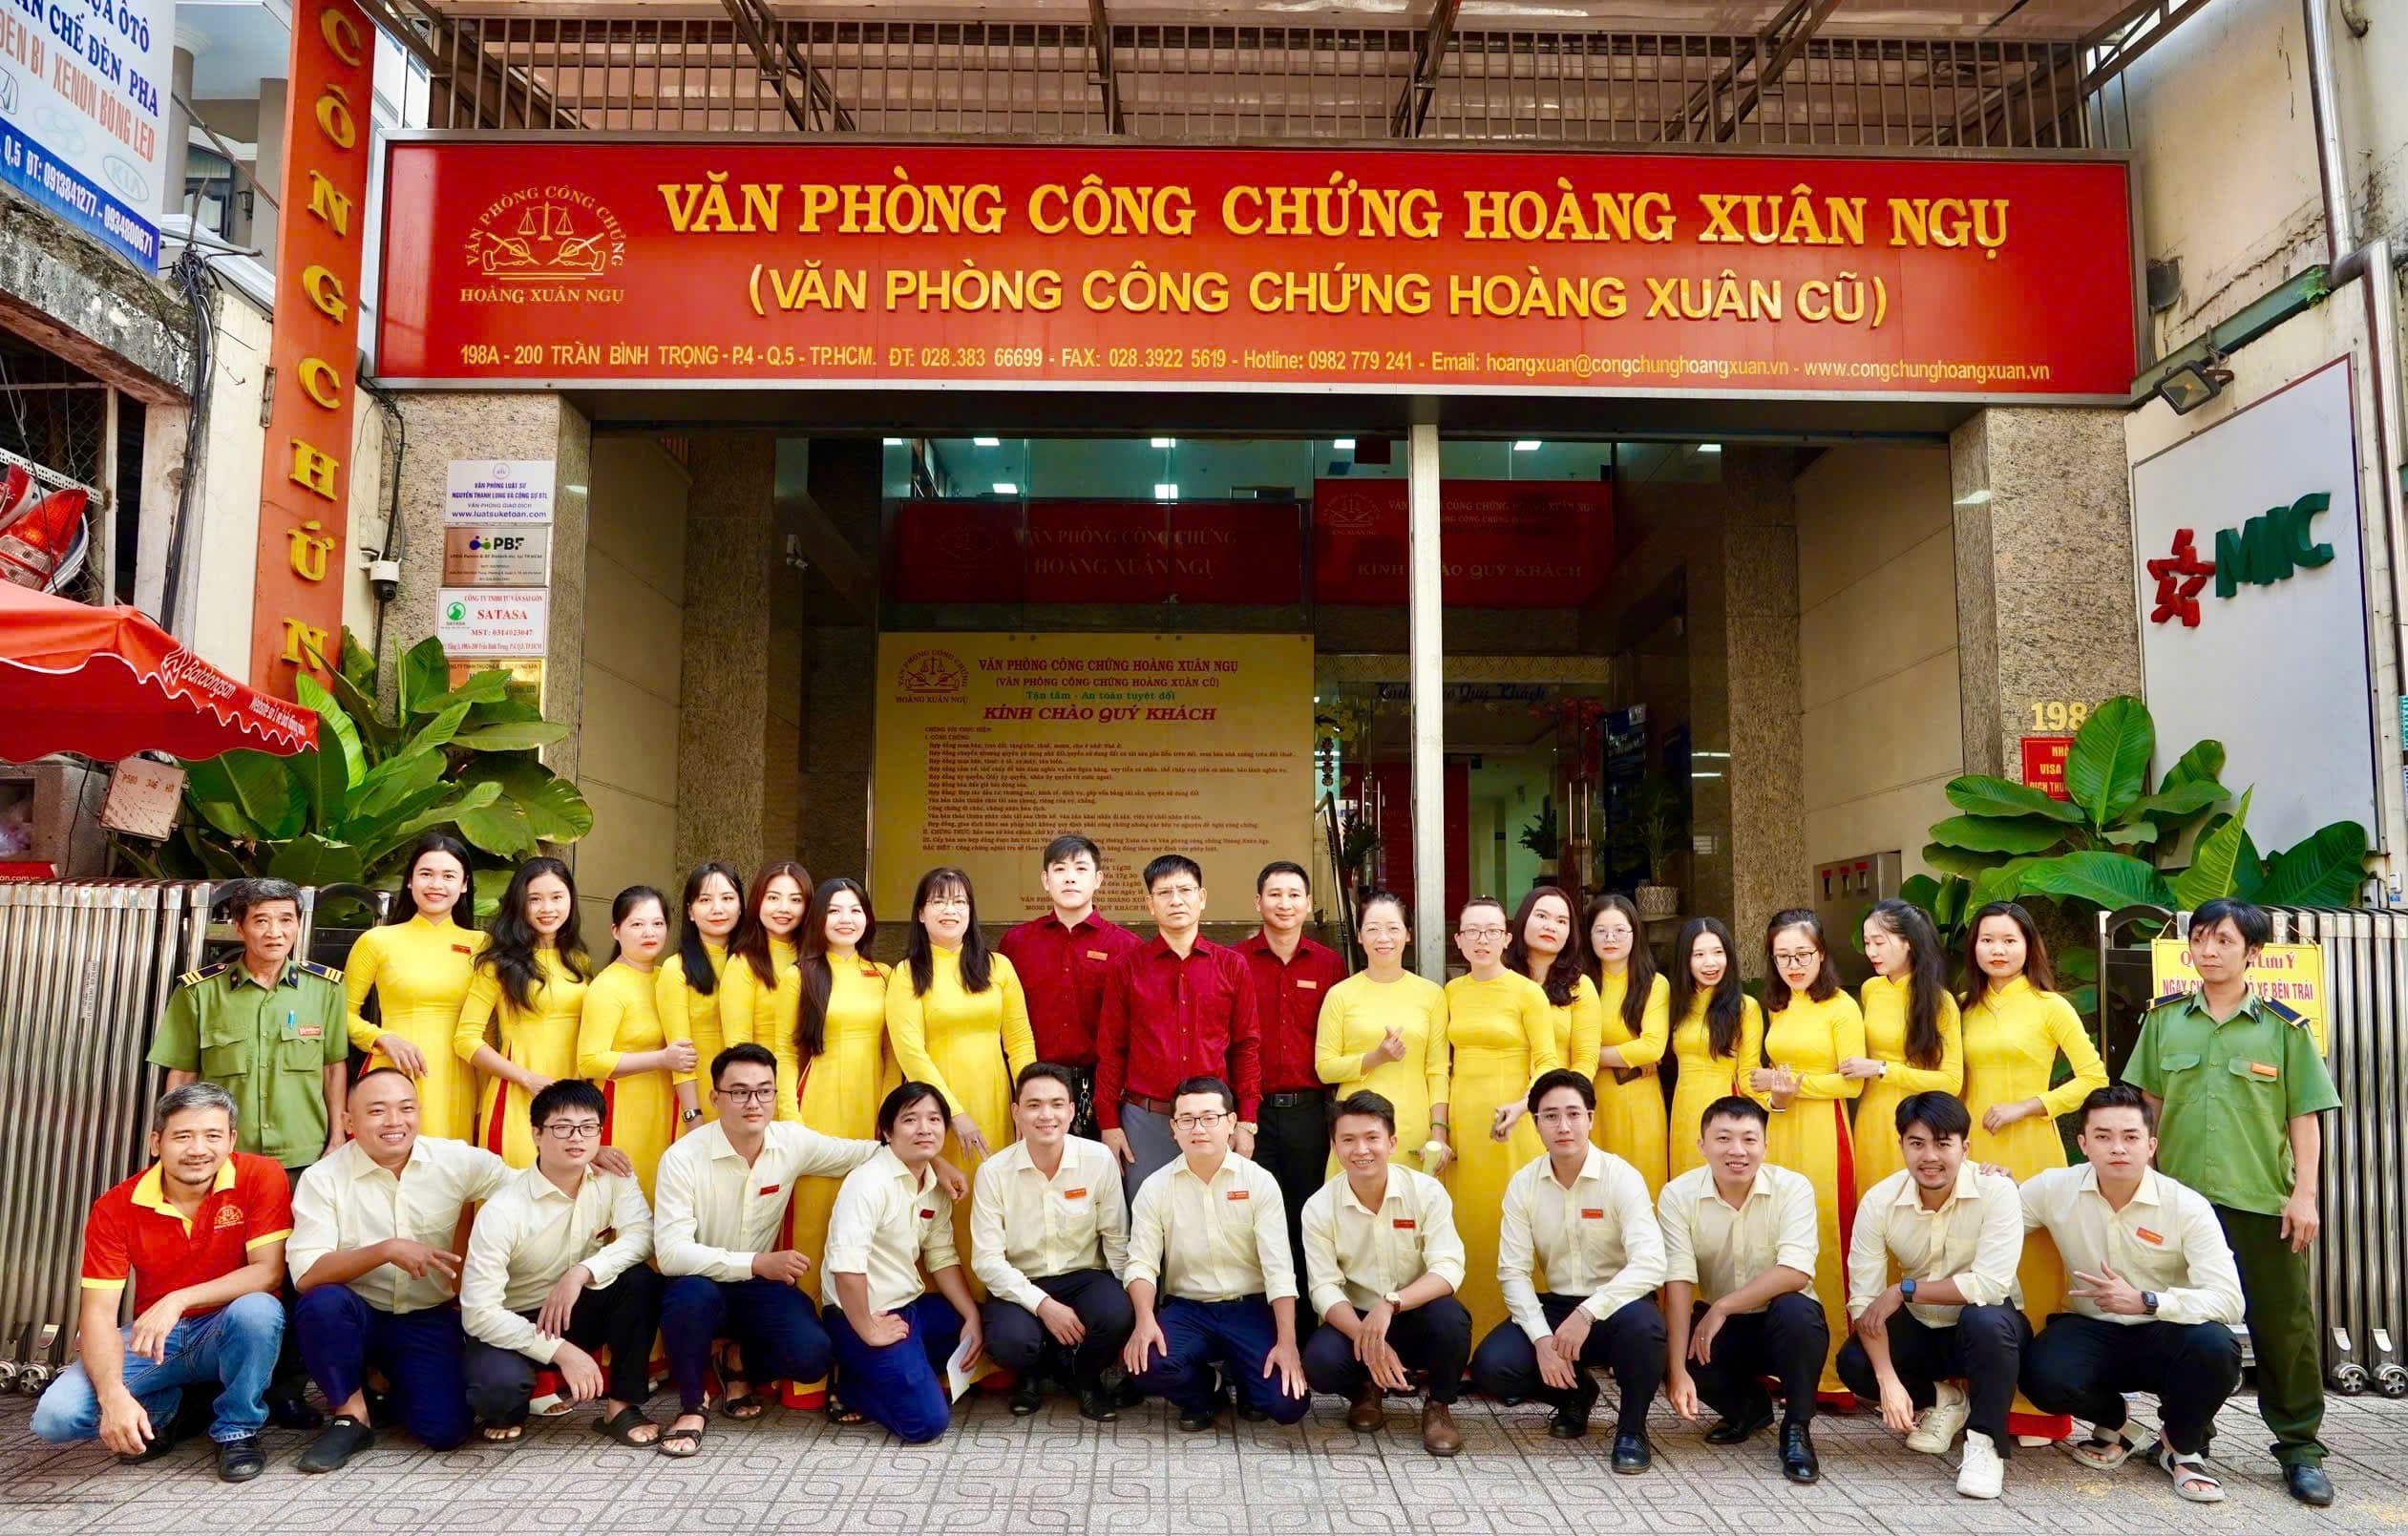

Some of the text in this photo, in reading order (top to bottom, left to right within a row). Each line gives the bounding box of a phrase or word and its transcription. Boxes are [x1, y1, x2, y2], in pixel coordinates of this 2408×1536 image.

[118, 0, 150, 53] ÔTÔ
[49, 4, 85, 55] CHẾ
[88, 34, 122, 86] ĐÈN
[129, 69, 158, 117] PHA
[31, 34, 45, 78] BI
[53, 53, 97, 119] XENON
[99, 87, 132, 145] BÓNG
[133, 115, 155, 162] LED
[4, 135, 22, 168] Q.5
[26, 150, 43, 181] ĐT:
[44, 161, 97, 218] 0913841277
[303, 8, 362, 324] CÔNG
[465, 184, 627, 268] VĂN PHÒNG CÔNG CHỨNG
[659, 166, 2010, 259] VĂN PHÒNG CÔNG CHỨNG HOÀNG XUÂN NGỤ
[460, 284, 624, 305] HOÀNG XUÂN NGỤ
[750, 259, 1888, 328] (VĂN PHÒNG CÔNG CHỨNG HOÀNG XUÂN CŨ)
[460, 344, 500, 365] 198A
[514, 344, 543, 365] 200
[551, 340, 601, 365] TRẦN
[609, 340, 649, 365] BÌNH
[658, 345, 719, 368] TRỌNG
[767, 346, 794, 367] Q.5
[888, 347, 916, 367] ĐT:
[920, 347, 986, 368] 028.383
[994, 347, 1044, 368] 66699
[1062, 347, 1101, 368] FAX:
[1109, 348, 1184, 368] 028.3922
[1191, 348, 1227, 369] 5619
[1244, 349, 1304, 370] Hotline:
[1308, 350, 1346, 370] 0982
[1352, 351, 1381, 370] 779
[1386, 351, 1412, 371] 241
[1432, 351, 1481, 372] Email:
[1487, 352, 1789, 379] hoangxuan@congchunghoangxuan.vn
[1805, 360, 2050, 384] www.congchunghoangxuan.vn
[494, 537, 524, 550] PBF
[476, 609, 527, 620] SATASA
[979, 657, 1238, 674] VĂN PHÒNG CÔNG CHỨNG HOÀNG XUÂN NGỤ
[1024, 677, 1058, 687] PHÒNG
[1061, 677, 1089, 687] CÔNG
[1132, 677, 1168, 687] HOÀNG
[1171, 677, 1200, 687] XUÂN
[983, 703, 1217, 724] KÍNH CHÀO QUÝ KHÁCH
[2031, 702, 2093, 731] 198
[2039, 764, 2062, 775] VISA
[2271, 978, 2290, 999] BÊN
[2292, 979, 2313, 1000] TRÁI
